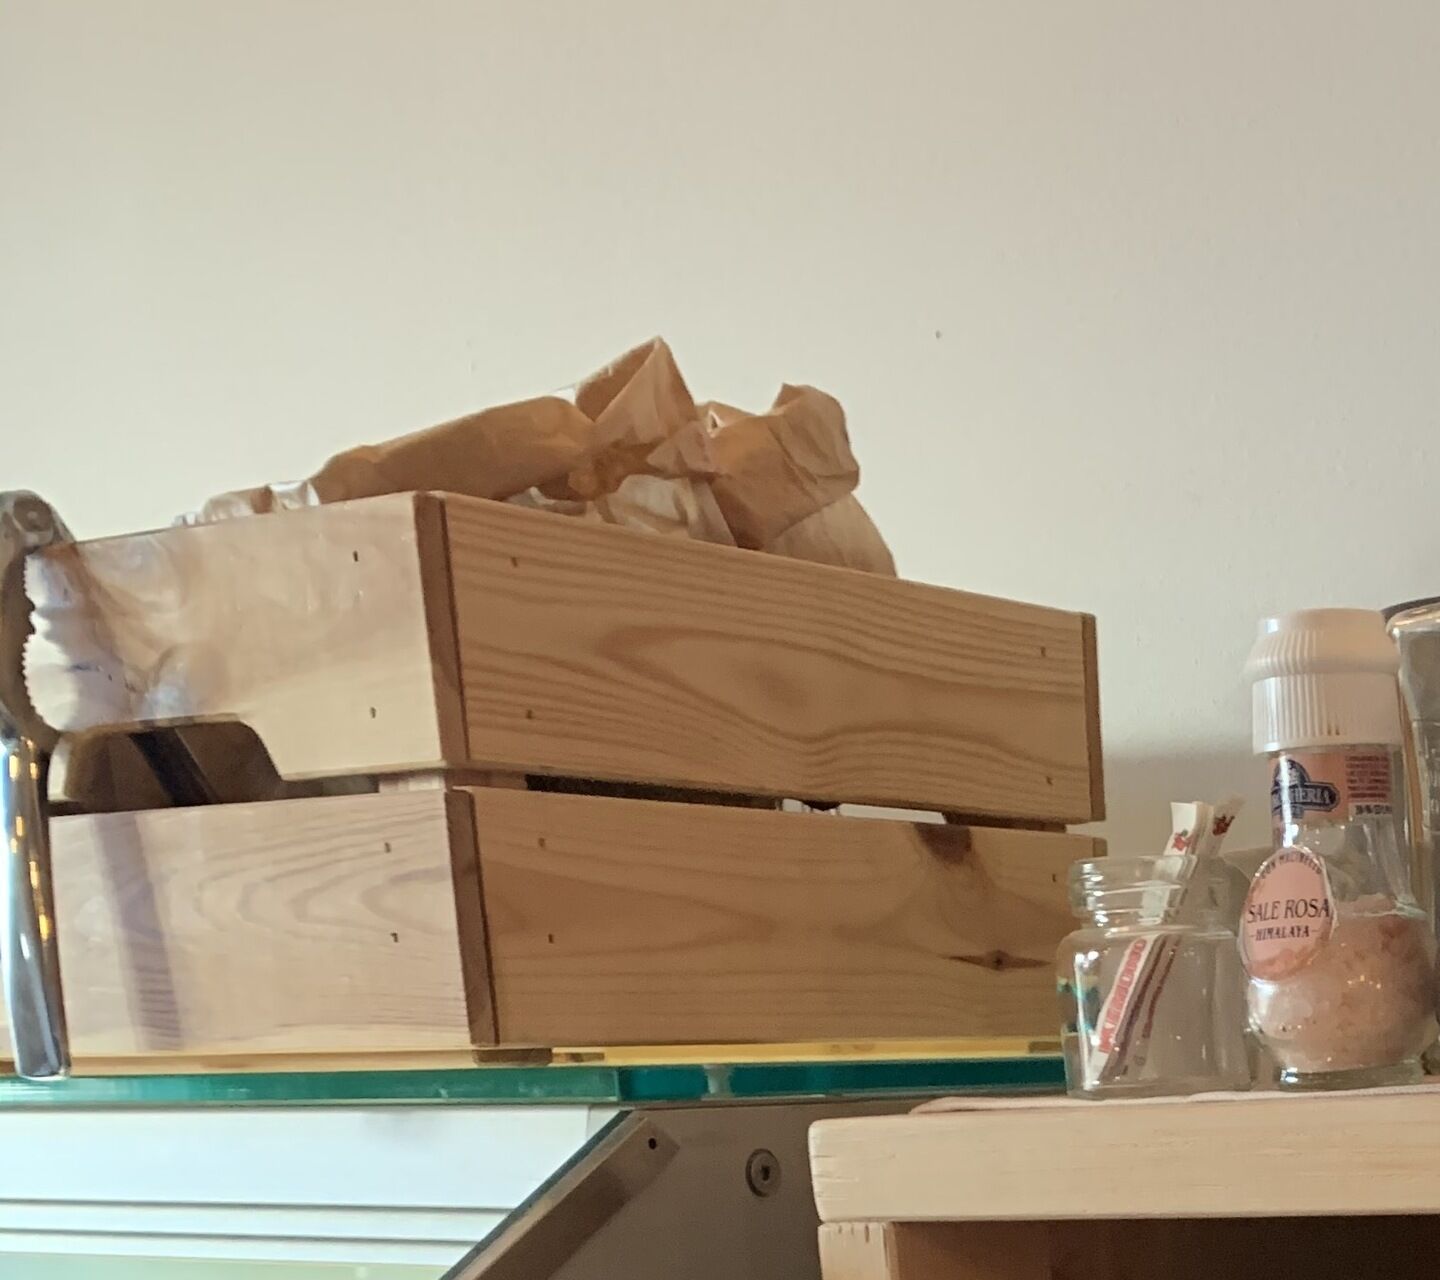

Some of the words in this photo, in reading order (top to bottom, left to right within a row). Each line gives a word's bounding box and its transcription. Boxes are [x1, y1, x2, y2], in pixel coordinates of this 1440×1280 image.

[1247, 901, 1281, 924] SALE
[1284, 898, 1331, 919] ROSA
[1256, 925, 1310, 941] HIMALAYA
